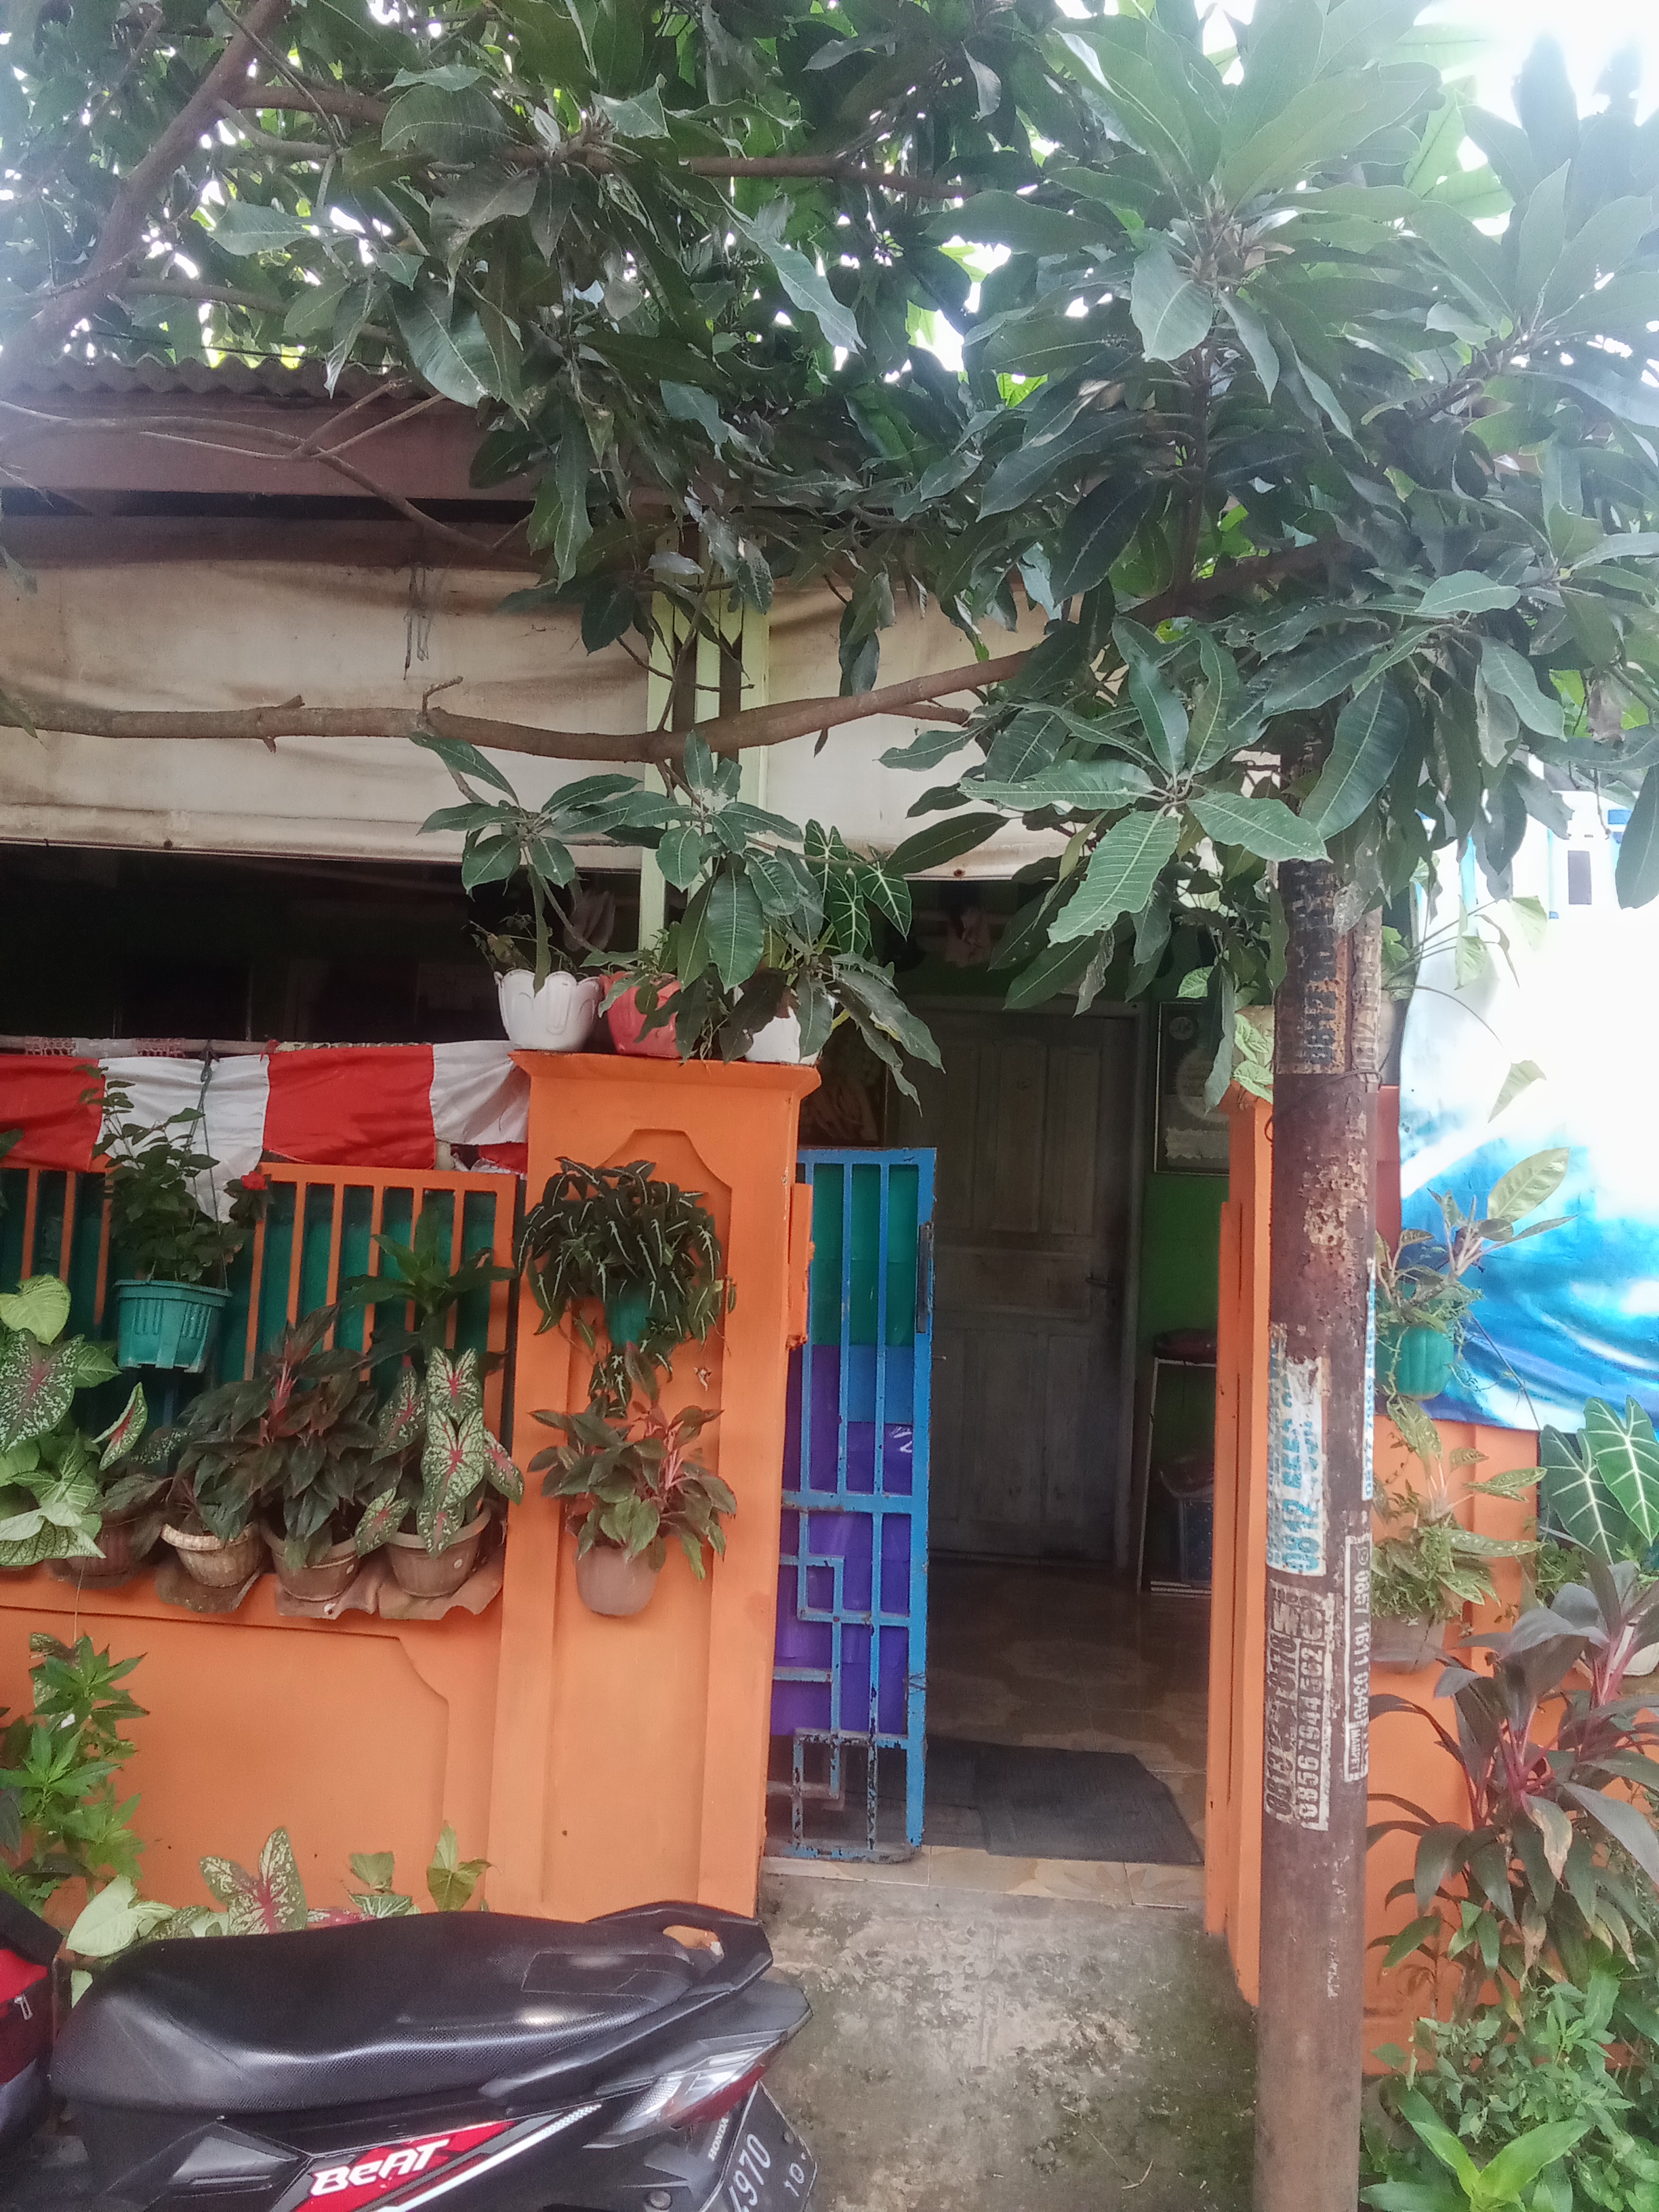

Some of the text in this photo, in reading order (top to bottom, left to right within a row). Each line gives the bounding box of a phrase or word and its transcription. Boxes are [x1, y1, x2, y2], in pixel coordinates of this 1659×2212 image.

[1282, 1499, 1319, 1571] 0812
[1353, 1569, 1369, 1614] 0857
[1353, 1622, 1369, 1666] 1611
[1350, 1727, 1361, 1771] MAMPET
[708, 2117, 729, 2161] HONDA
